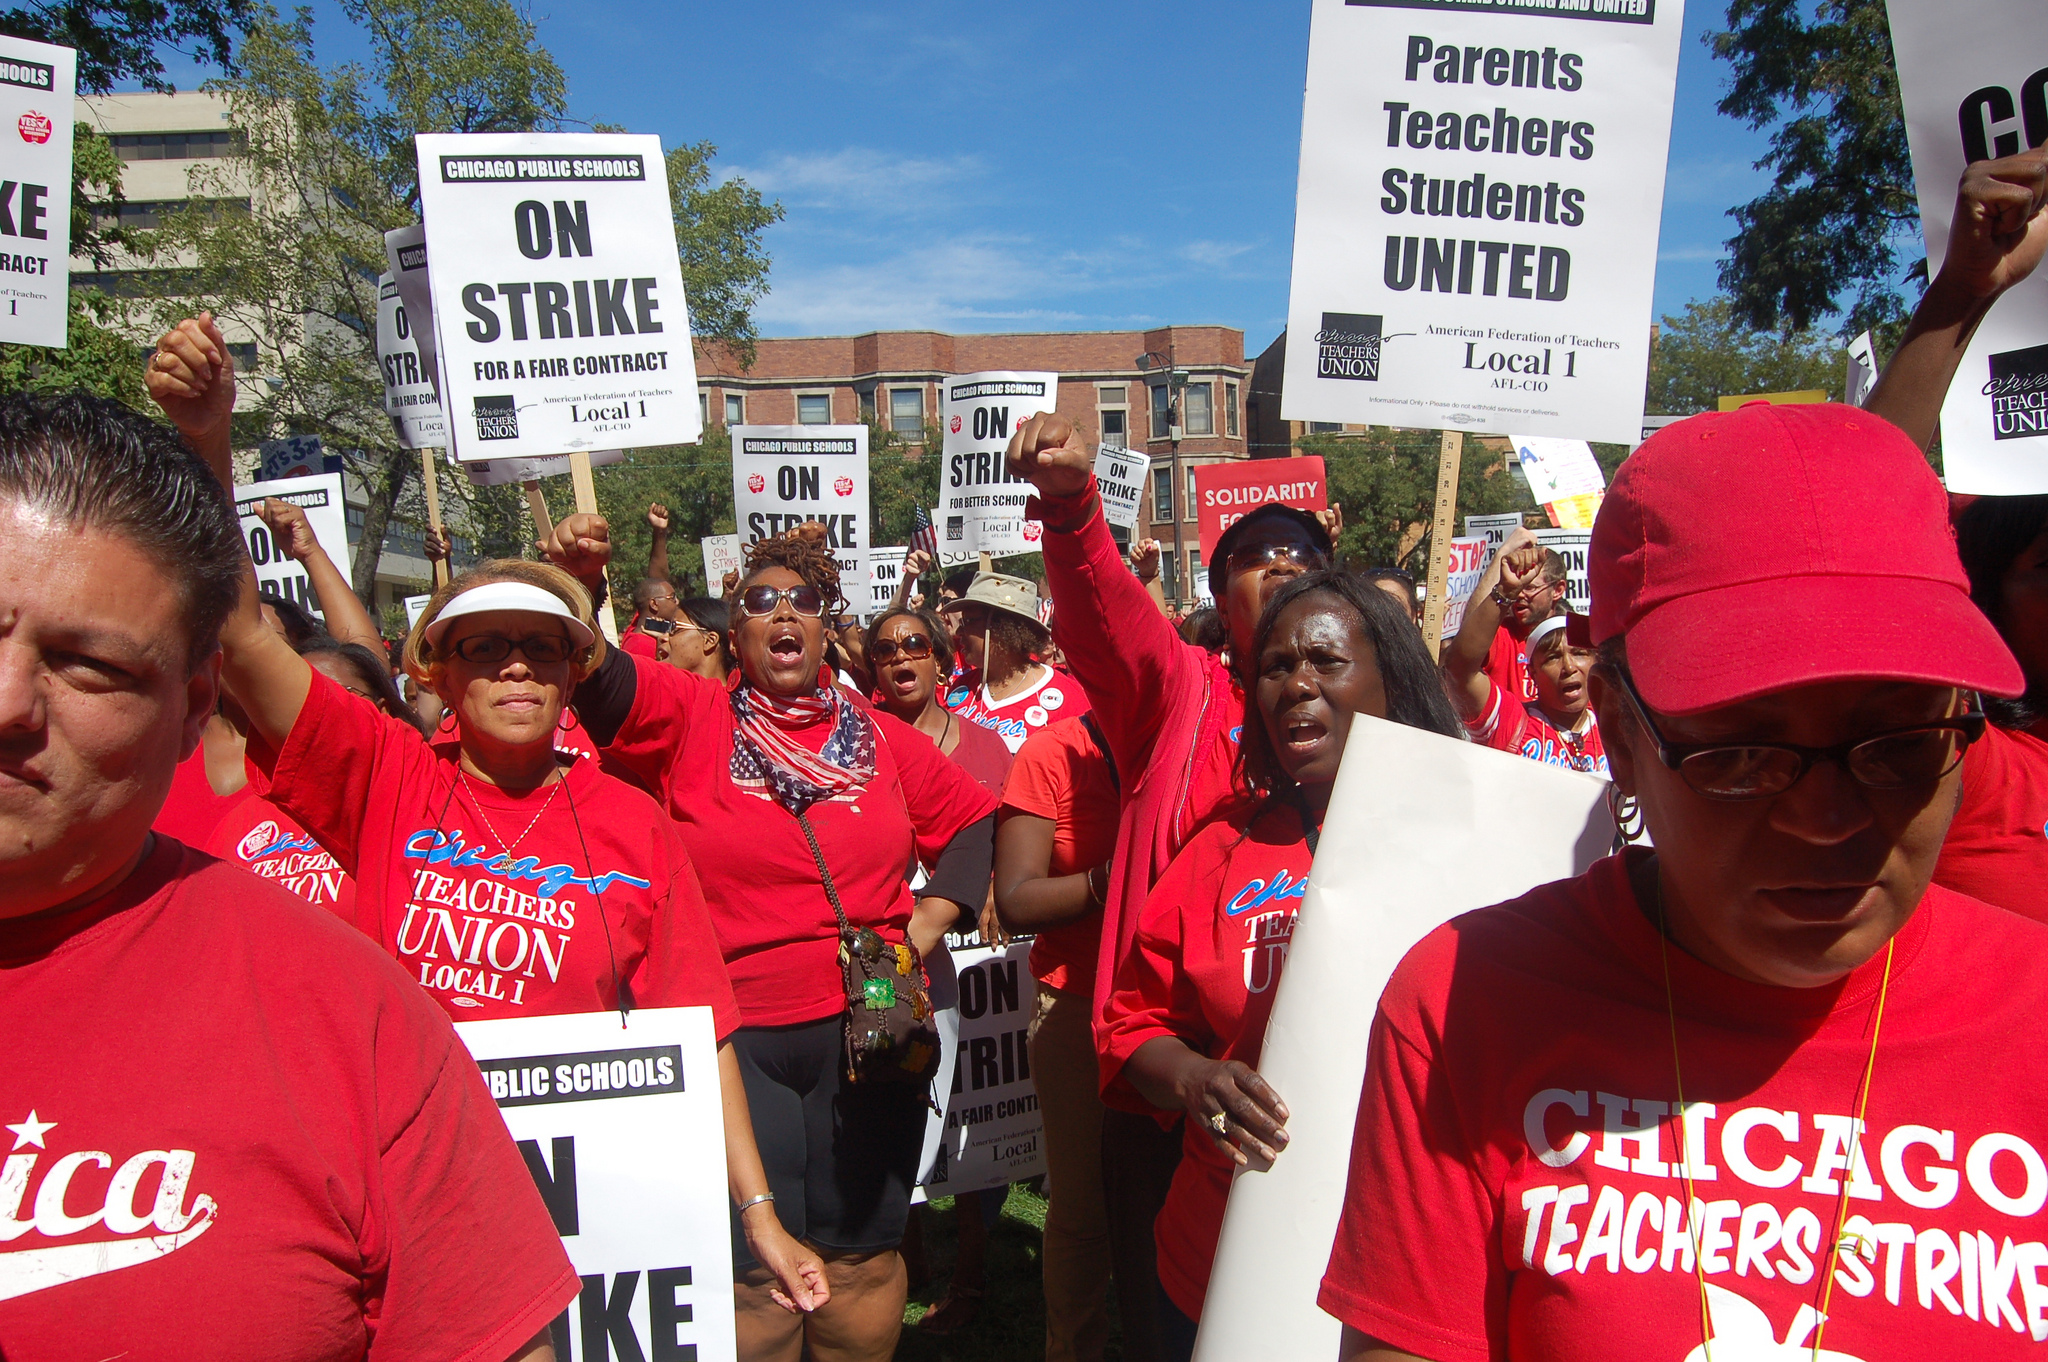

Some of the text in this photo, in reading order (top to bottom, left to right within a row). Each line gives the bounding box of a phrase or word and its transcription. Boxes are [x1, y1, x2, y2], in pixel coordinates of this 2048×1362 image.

[1592, 0, 1647, 15] UNITED
[1405, 35, 1583, 92] Parents
[1383, 101, 1594, 161] Teachers
[446, 159, 640, 179] CHICAGO PUBLIC SCHOOLS
[1381, 167, 1585, 227] Students
[514, 199, 593, 260] ON
[1383, 235, 1572, 302] UNITED
[10, 289, 47, 300] Teachers
[9, 299, 18, 316] 1
[461, 277, 664, 343] STRIKE
[1314, 328, 1416, 346] Chicago
[1425, 324, 1620, 350] American Federation of Teachers
[1320, 343, 1379, 359] TEACHERS
[1462, 342, 1577, 378] Local 1
[474, 352, 668, 381] FOR A FAIR CONTRACT
[1320, 357, 1378, 377] UNION
[543, 395, 582, 404] American
[583, 392, 624, 402] Federation
[637, 388, 673, 397] Teachers
[953, 383, 1043, 399] CHICAGO PUBLIC SCHOOLS
[1490, 377, 1548, 393] AFL-CIO
[571, 400, 648, 424] Local 1
[1369, 396, 1408, 405] Informational
[1429, 400, 1451, 408] Please
[477, 416, 516, 427] TEACHERS
[478, 425, 518, 438] UNION
[592, 423, 631, 433] AFL-CIO
[973, 406, 1009, 440] ON
[1994, 408, 2048, 434] UNI
[745, 441, 854, 453] CHICAGO PUBLIC SCHOOLS
[950, 450, 1032, 488] STRI
[1110, 462, 1128, 479] ON
[777, 465, 820, 501] ON
[1096, 477, 1138, 501] STRIKE
[1205, 481, 1318, 507] SOLIDARITY
[950, 497, 963, 509] FOR
[964, 496, 990, 508] BETTER
[748, 512, 857, 549] STRKE
[982, 521, 1021, 532] Local 1
[711, 536, 728, 546] CPS
[713, 548, 728, 557] ON
[711, 557, 739, 570] STRIKE
[1448, 540, 1487, 574] STOP
[877, 564, 896, 580] ON
[403, 828, 651, 898] Chicago
[412, 868, 577, 931] TEACHERS
[396, 902, 571, 984] UNION
[1241, 942, 1292, 994] U
[418, 961, 526, 1005] LOCAL 1
[958, 959, 1019, 1020] ON
[481, 1055, 675, 1099] BLIC SCHOOLS
[947, 1111, 959, 1129] A
[961, 1104, 993, 1126] FAIR
[970, 1136, 1002, 1148] American
[1003, 1127, 1036, 1141] Federation
[993, 1135, 1037, 1162] Local
[1009, 1154, 1037, 1168] AFL-CIO
[1523, 1088, 2048, 1218] CHICAGO
[1521, 1184, 1822, 1285] TEACHERS
[1833, 1214, 2048, 1342] STRIKE
